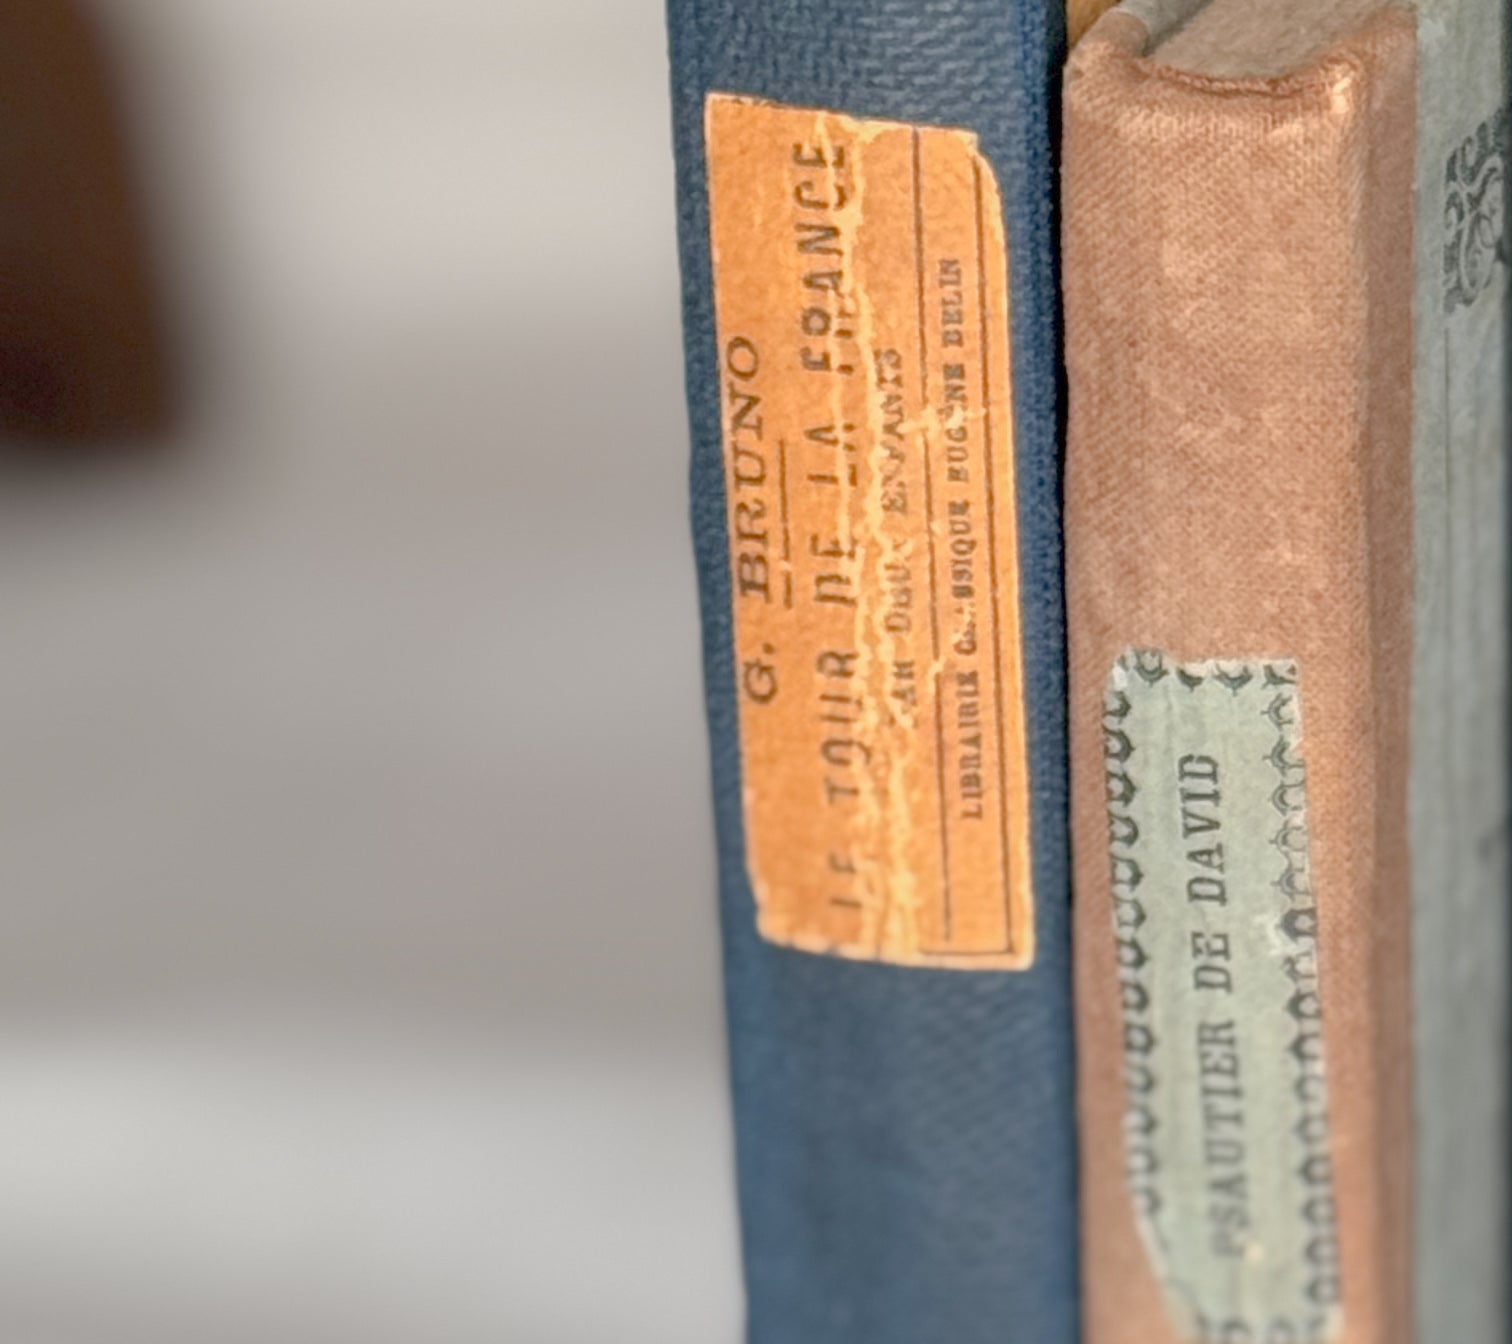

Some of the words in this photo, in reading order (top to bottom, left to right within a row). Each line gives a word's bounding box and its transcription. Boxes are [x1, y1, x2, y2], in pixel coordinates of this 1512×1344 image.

[791, 142, 857, 376] FRANCE
[938, 258, 966, 350] BELIN
[727, 335, 771, 605] BRUNO
[803, 421, 860, 488] LA
[941, 499, 978, 656] CSSIQUE
[741, 642, 780, 707] G.
[815, 649, 874, 805] TOUR
[955, 670, 985, 821] LIBRAIRIE
[1178, 753, 1229, 907] DAVID
[1191, 930, 1234, 995] DE
[1197, 1018, 1251, 1258] PSAUTIER
